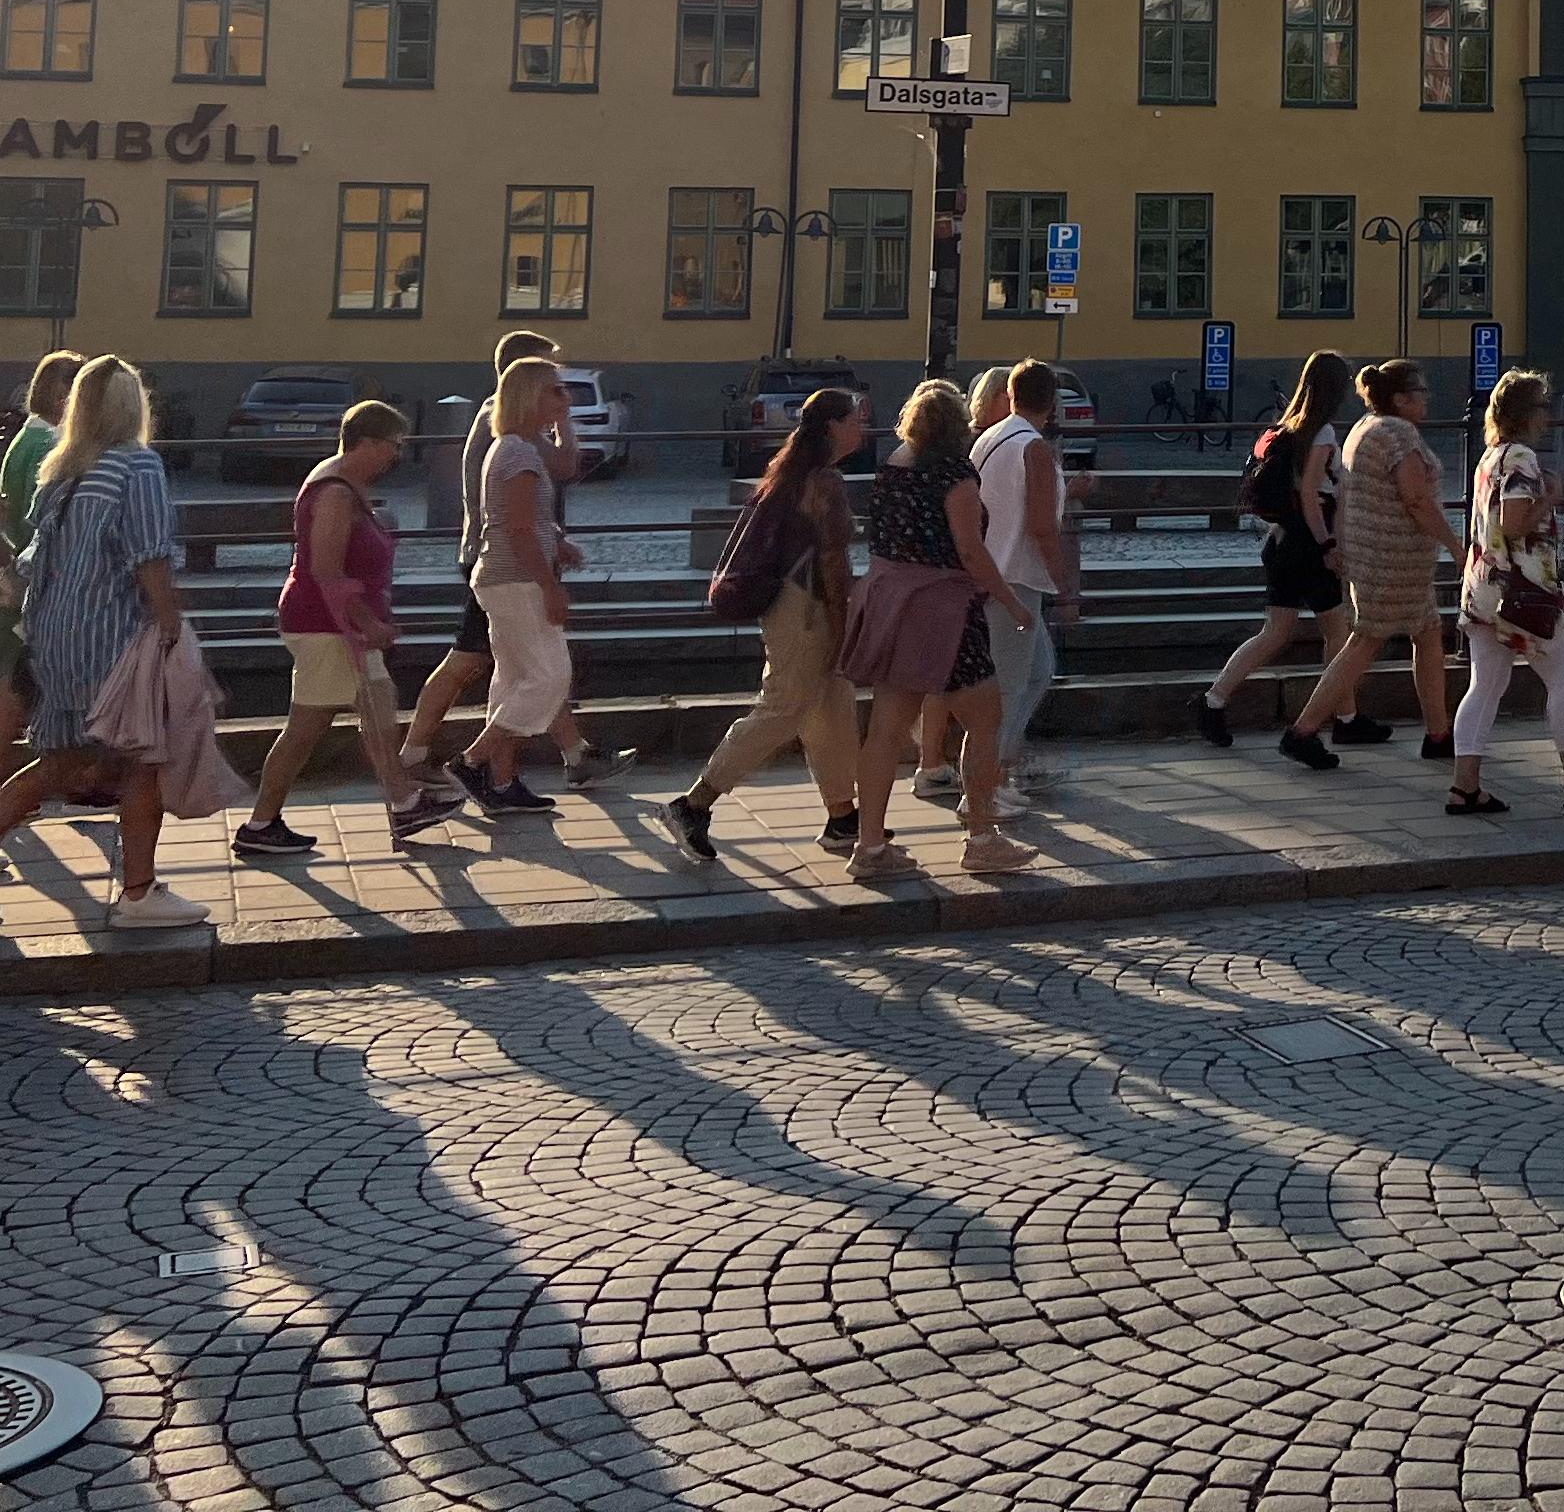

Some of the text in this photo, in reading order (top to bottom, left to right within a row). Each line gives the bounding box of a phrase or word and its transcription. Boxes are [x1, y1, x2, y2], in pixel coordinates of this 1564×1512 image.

[1057, 227, 1073, 248] P
[1213, 328, 1225, 344] P
[1481, 330, 1491, 345] P
